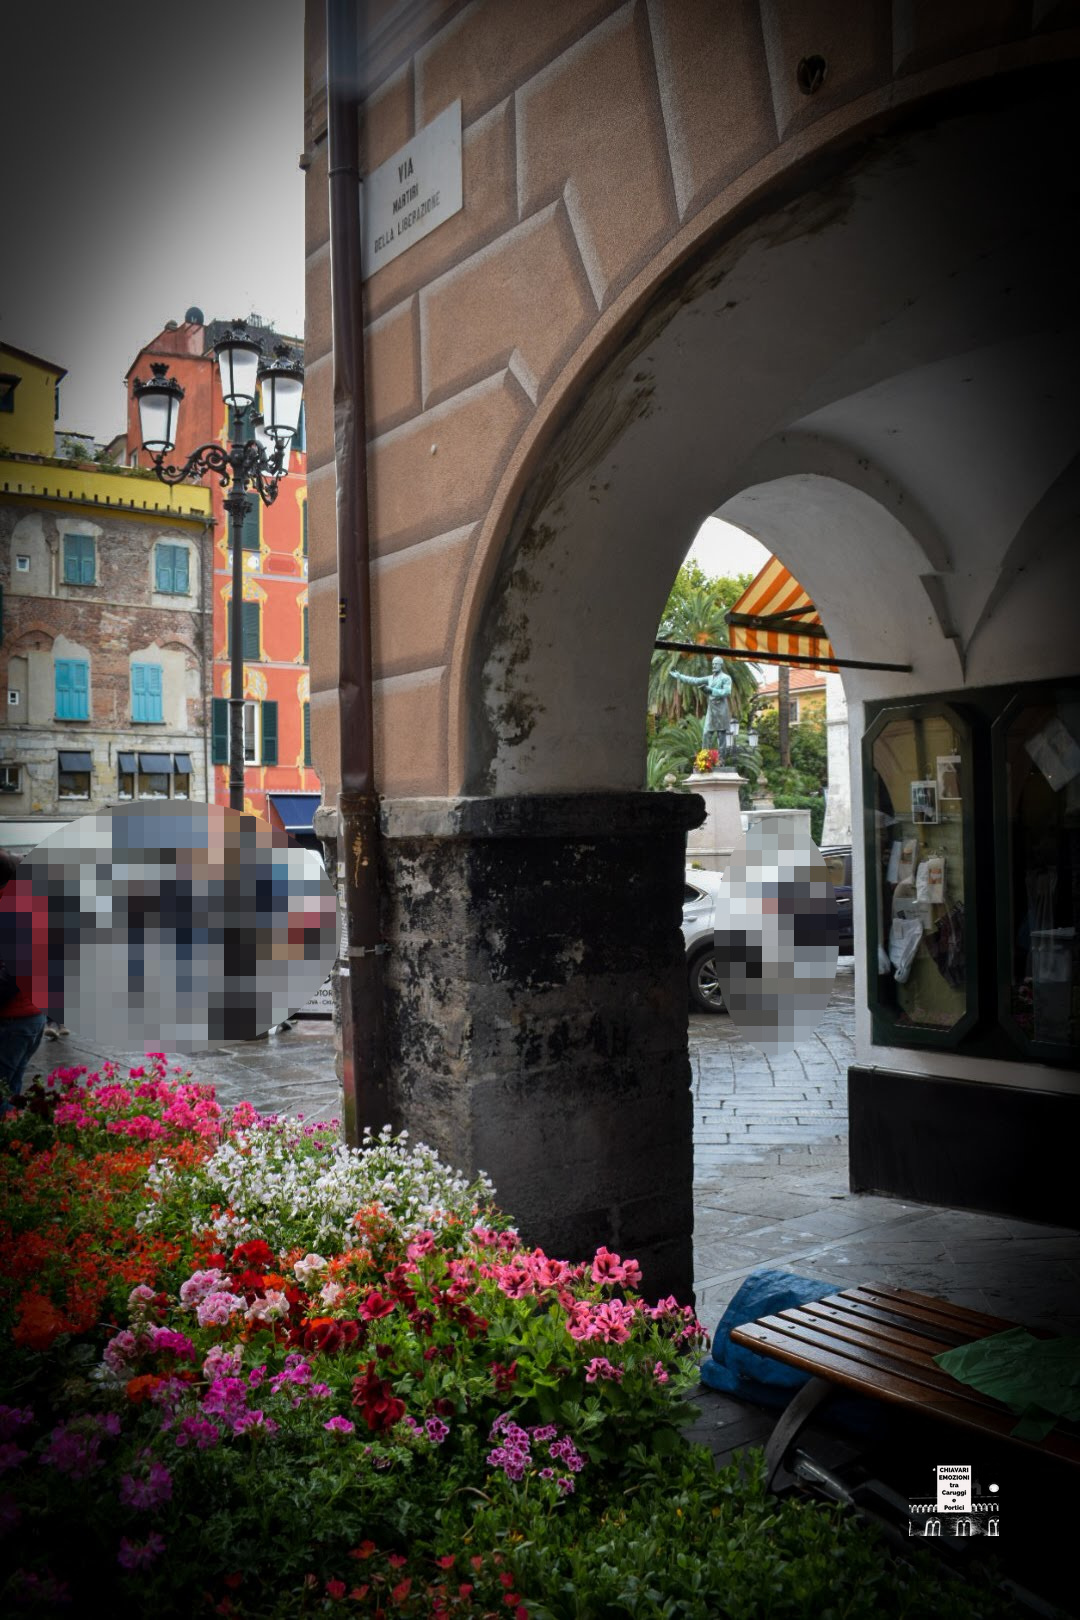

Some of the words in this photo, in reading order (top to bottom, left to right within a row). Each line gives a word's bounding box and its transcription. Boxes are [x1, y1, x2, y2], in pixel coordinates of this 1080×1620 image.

[398, 157, 414, 183] VIA
[392, 184, 419, 215] MARTIRI
[374, 228, 394, 254] DELLA
[397, 191, 441, 236] LIBERAZIONE
